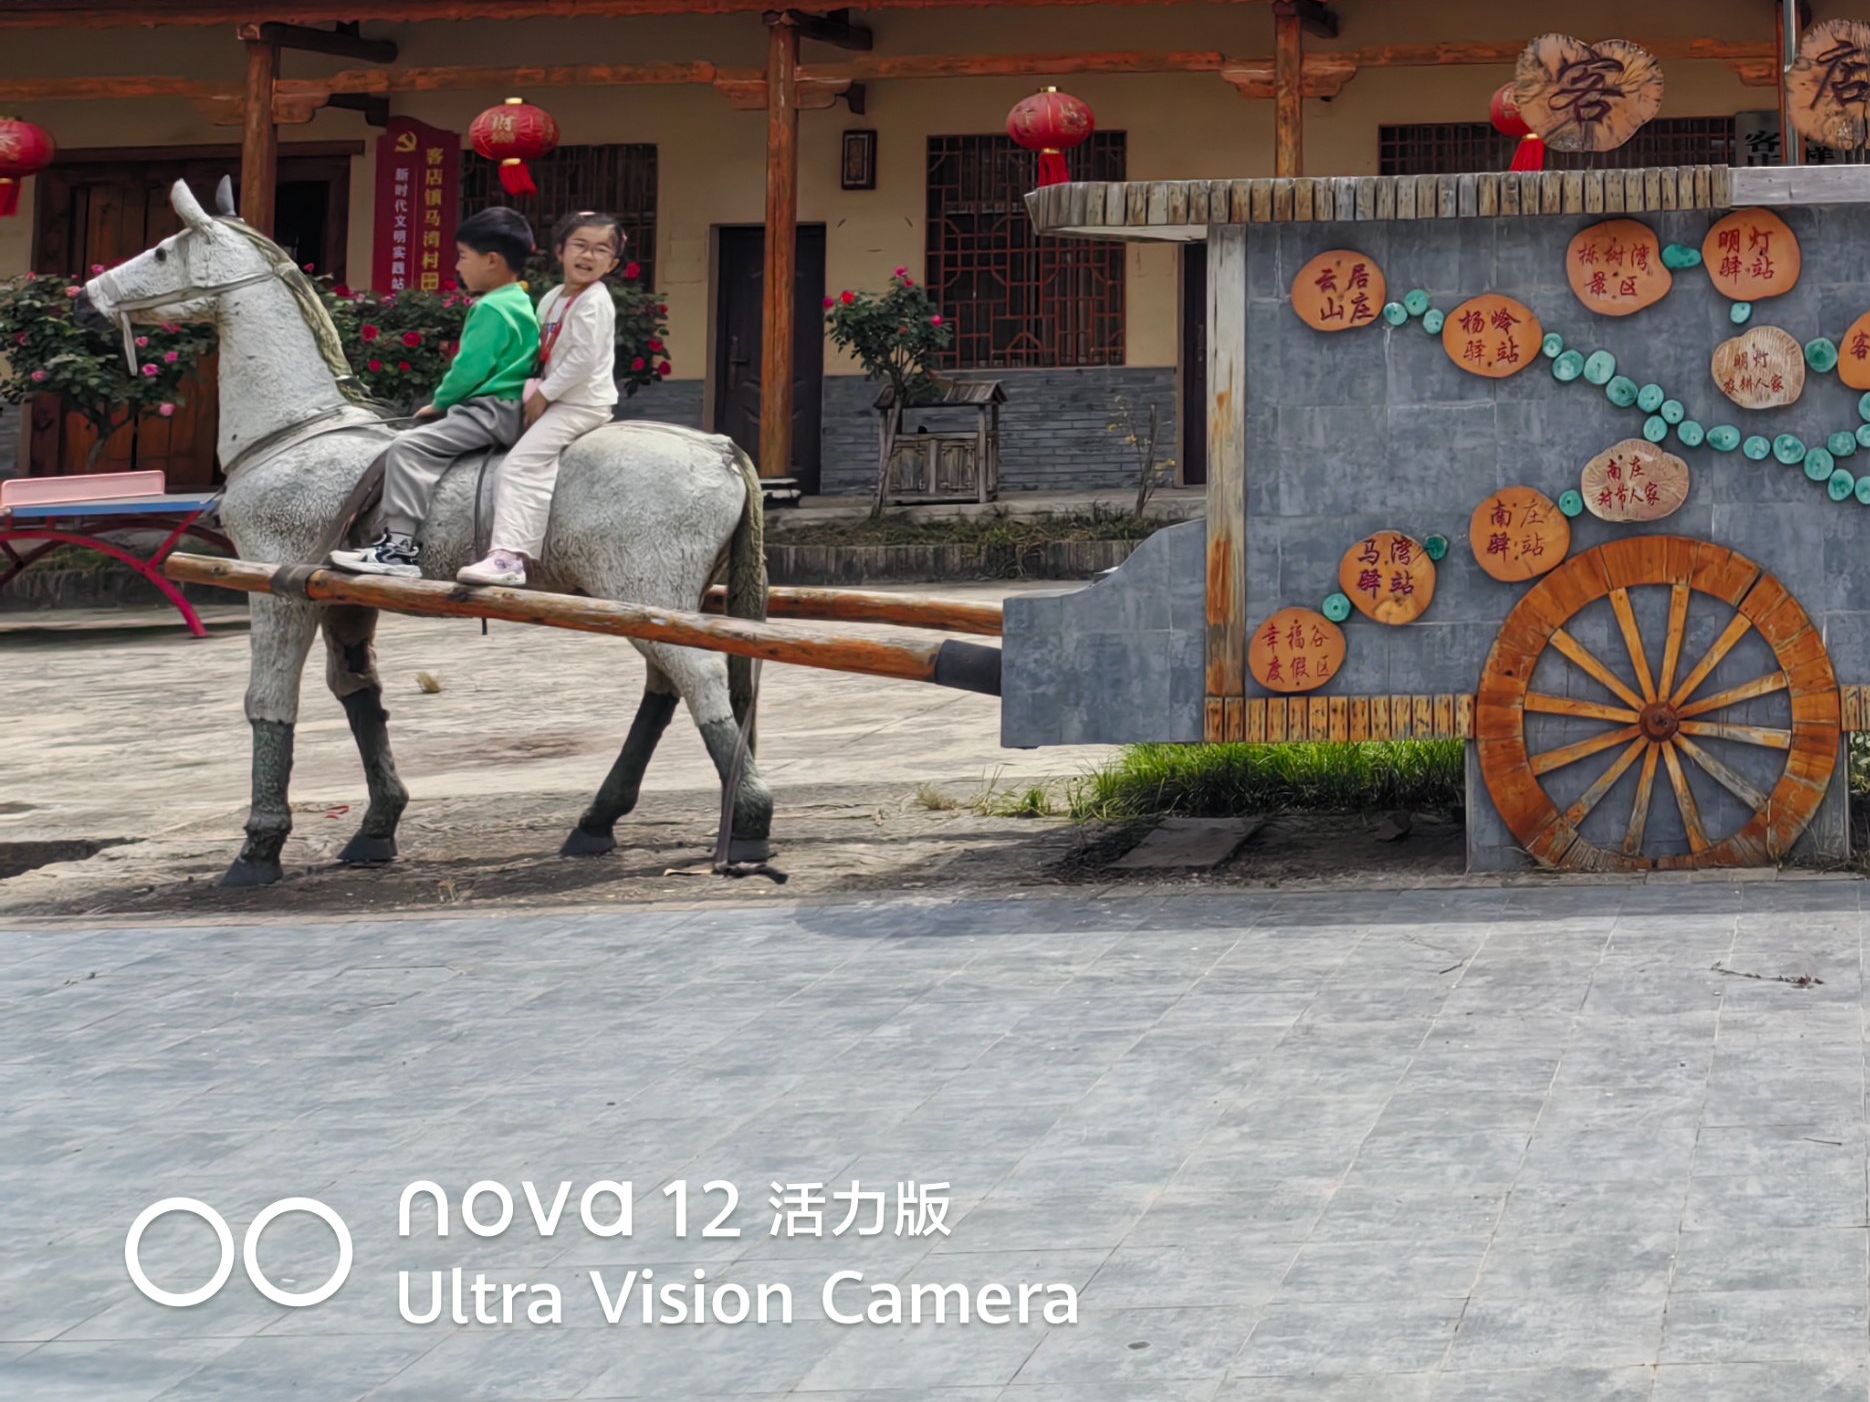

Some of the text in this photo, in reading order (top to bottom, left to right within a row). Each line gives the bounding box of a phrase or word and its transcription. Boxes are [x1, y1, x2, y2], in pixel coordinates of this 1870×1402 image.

[1719, 227, 1773, 254] 明灯
[1315, 263, 1370, 291] 云居
[1585, 271, 1638, 297] 景区
[1720, 257, 1774, 285] 驿站
[1320, 295, 1374, 323] 山庄
[1459, 309, 1521, 334] 杨岭
[1464, 339, 1519, 365] 驿站
[1734, 350, 1768, 369] 明灯
[1607, 456, 1645, 481] 南庄
[1490, 499, 1544, 529] 南庄
[1358, 536, 1412, 565] 马湾
[1487, 532, 1544, 563] 驿站
[1356, 569, 1414, 599] 驿站
[1261, 622, 1330, 653] 幸福谷
[1265, 656, 1330, 683] 度假区
